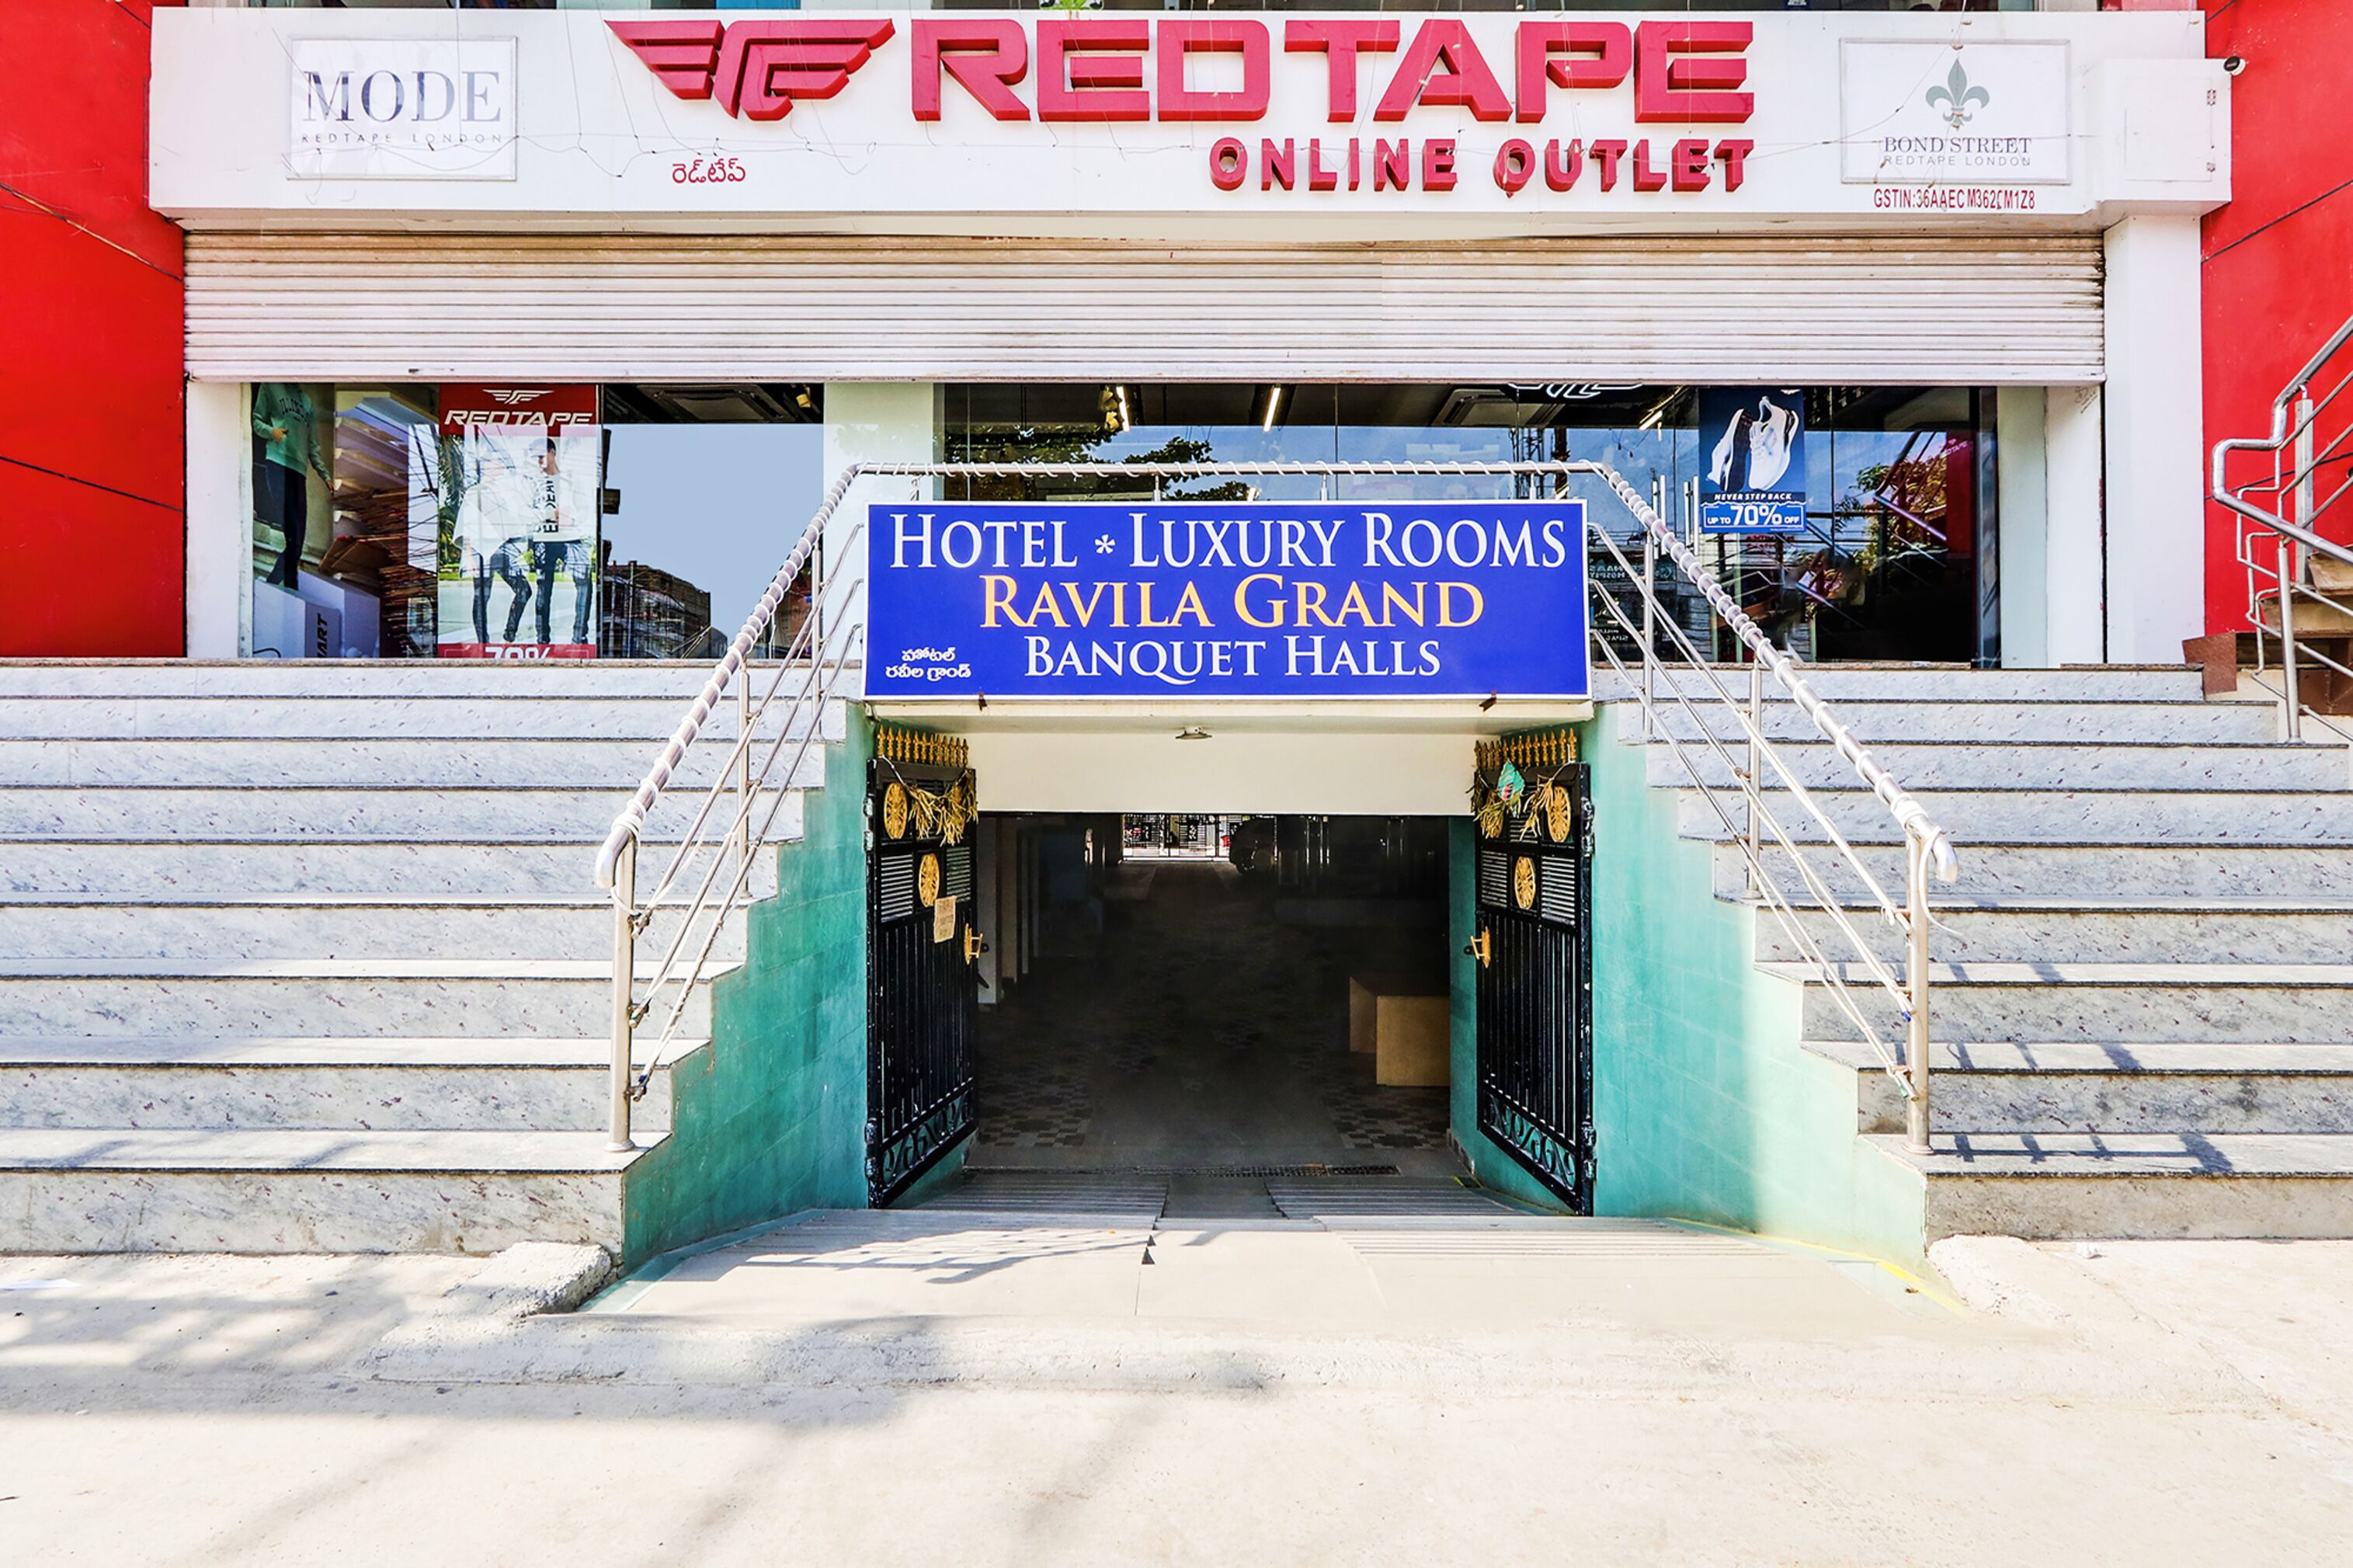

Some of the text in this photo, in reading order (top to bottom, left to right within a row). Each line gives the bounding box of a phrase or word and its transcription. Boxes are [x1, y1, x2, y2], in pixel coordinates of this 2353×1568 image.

[911, 19, 1755, 123] REDTAPE
[303, 70, 501, 122] MODE
[302, 133, 502, 144] REDTAPE LONDON
[1884, 137, 2033, 154] BOND STREET
[1884, 155, 2031, 166] REDTAPE LONDON
[1209, 137, 1754, 192] ONLINE OUTLET
[444, 410, 593, 426] REDTAPE
[889, 512, 1566, 568] HOTEL LUXURY ROOMS
[1730, 505, 1782, 526] 70%
[979, 573, 1485, 628] RAVILA GRAND
[1024, 635, 1441, 684] BANQUET HALLS
